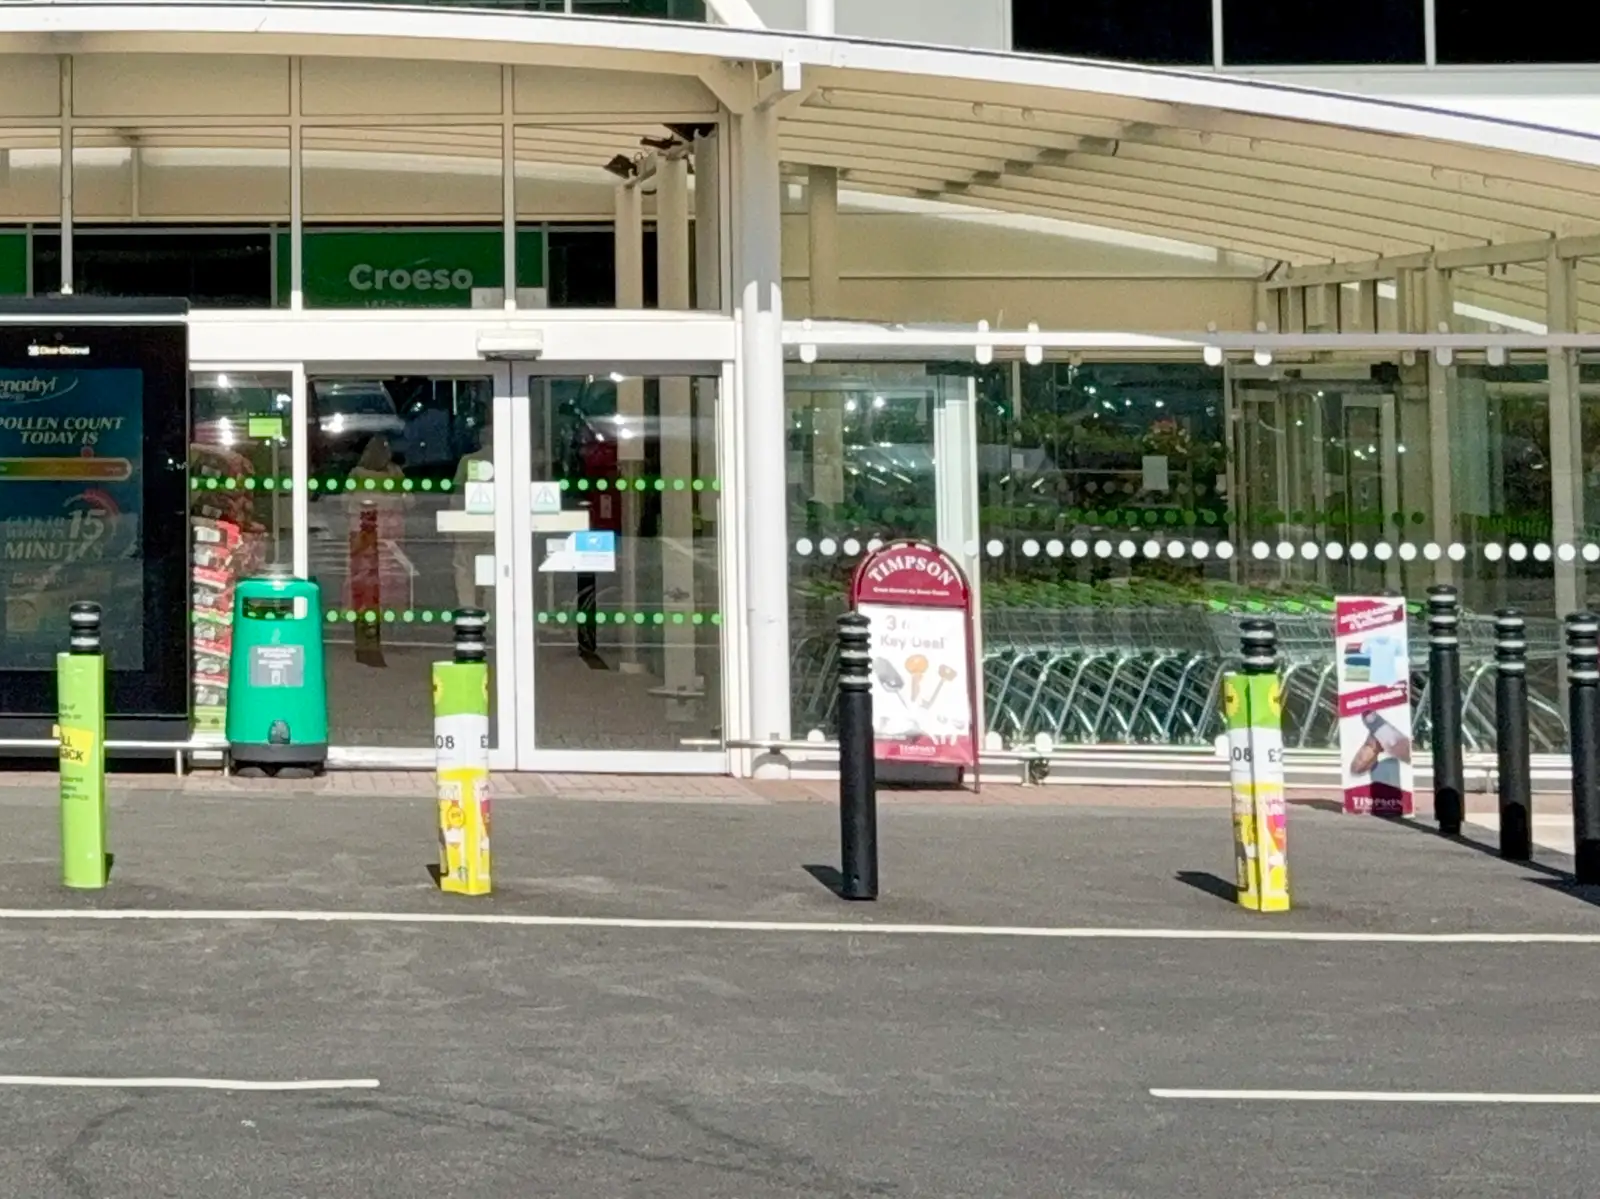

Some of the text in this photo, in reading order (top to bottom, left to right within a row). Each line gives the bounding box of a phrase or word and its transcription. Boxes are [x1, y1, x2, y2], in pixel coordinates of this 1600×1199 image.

[349, 264, 473, 290] Croeso
[63, 416, 126, 431] COUNT
[20, 431, 100, 445] TODAY IS
[68, 509, 106, 542] 15
[868, 555, 955, 586] TIMPSON
[885, 614, 898, 631] 3
[880, 634, 906, 650] Key
